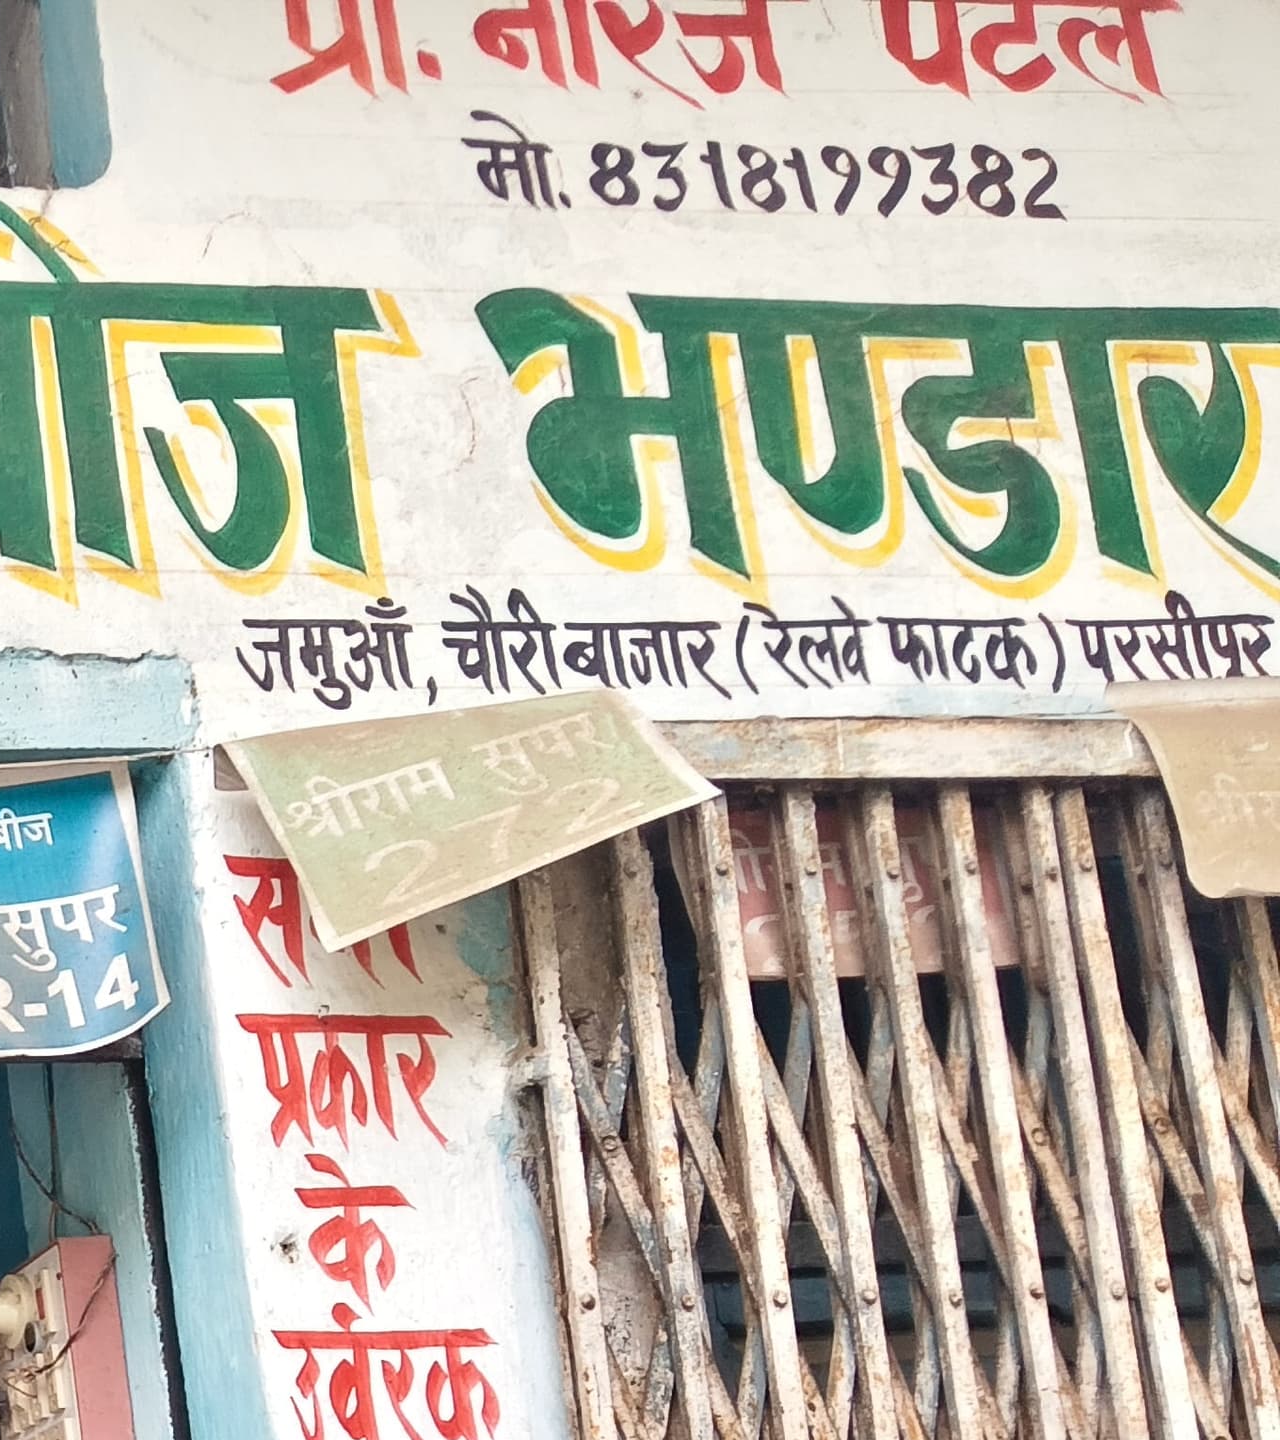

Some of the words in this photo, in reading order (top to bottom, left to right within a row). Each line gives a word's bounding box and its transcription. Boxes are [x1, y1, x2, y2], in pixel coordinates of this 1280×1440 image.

[461, 109, 572, 210] मो.
[589, 138, 1068, 221] 8318199382
[474, 286, 1280, 592] भण्डार
[283, 755, 457, 839] श्रीराम
[235, 1012, 454, 1152] प्रकार
[294, 1152, 417, 1317] के
